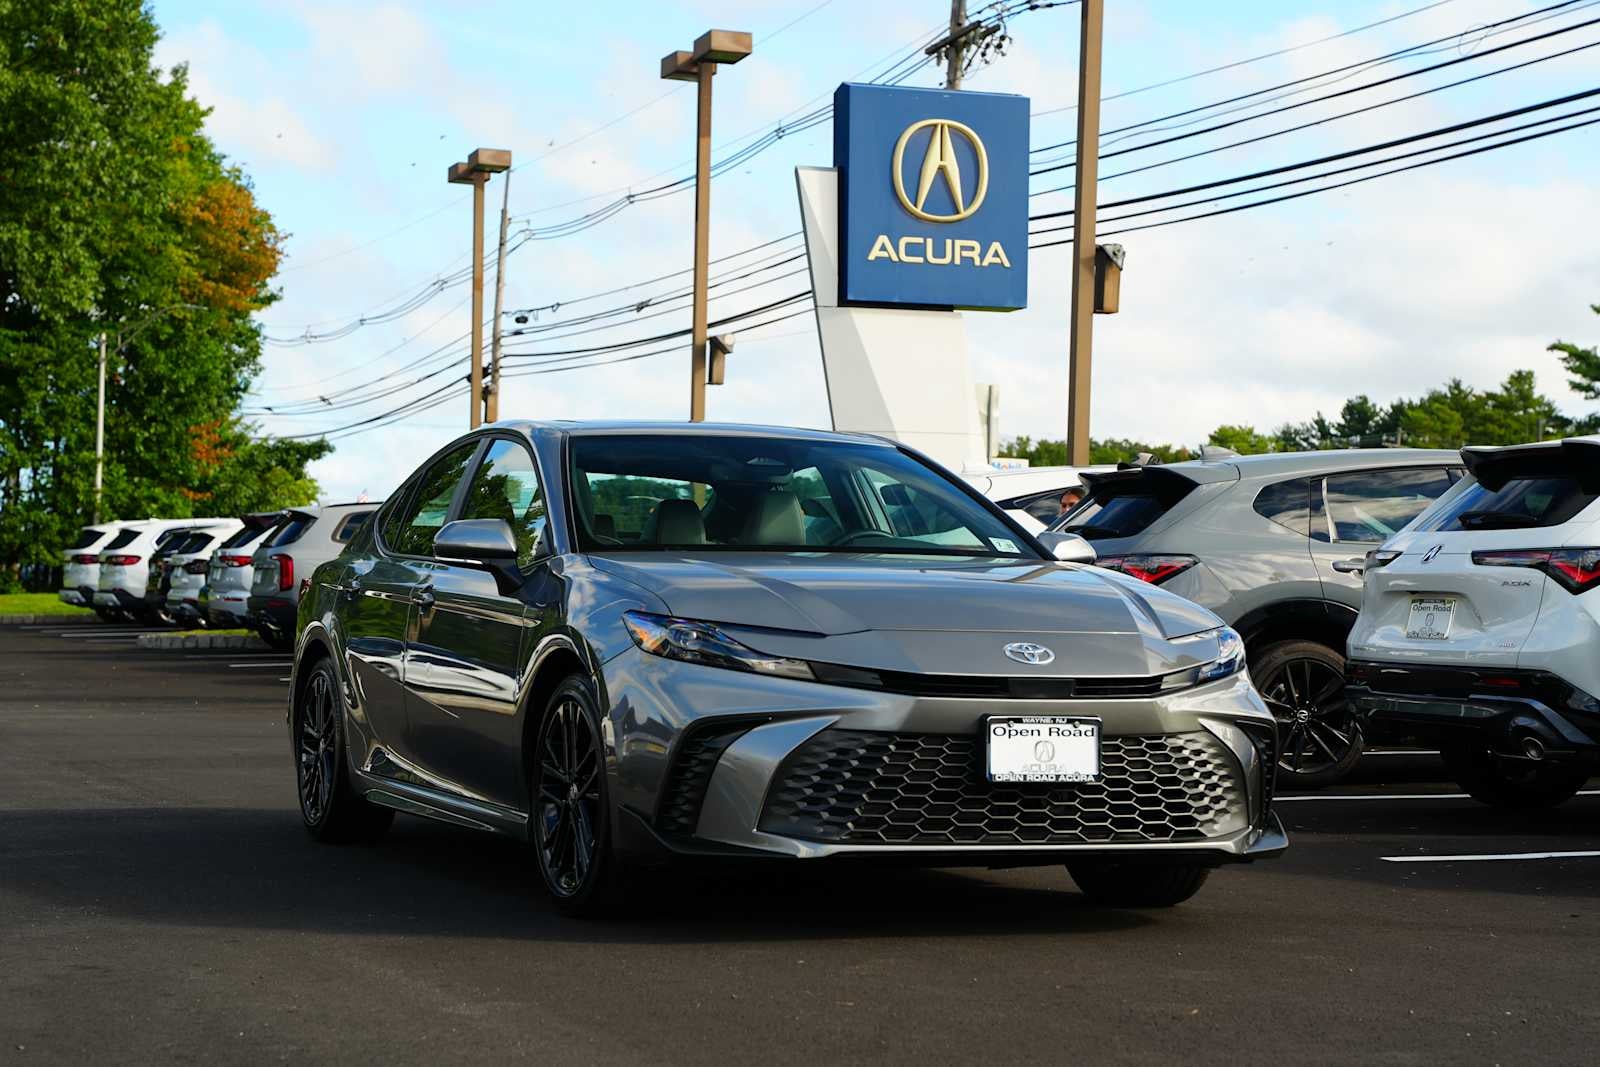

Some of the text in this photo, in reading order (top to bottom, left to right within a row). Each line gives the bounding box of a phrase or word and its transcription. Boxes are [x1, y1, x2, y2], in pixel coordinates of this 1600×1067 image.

[867, 235, 1011, 268] ACURA
[1413, 604, 1451, 613] Open Road
[993, 726, 1095, 739] Open Road
[1023, 763, 1067, 773] ACURA
[994, 774, 1095, 782] OPEN ROAD ACURA
